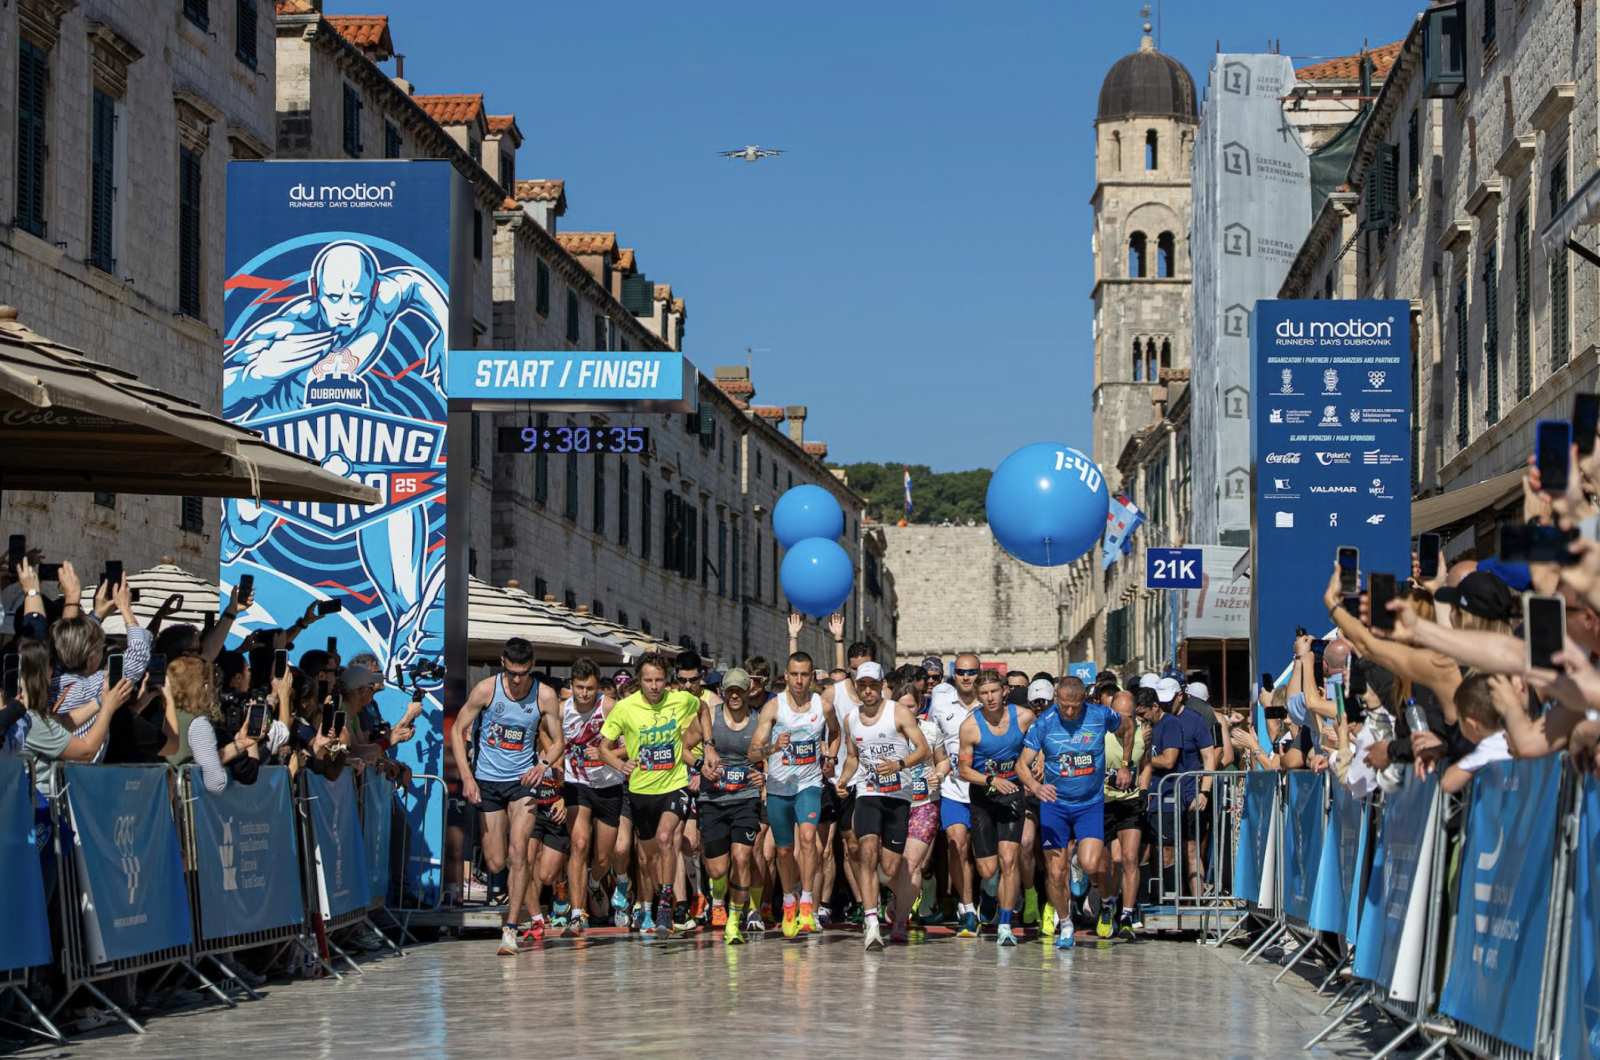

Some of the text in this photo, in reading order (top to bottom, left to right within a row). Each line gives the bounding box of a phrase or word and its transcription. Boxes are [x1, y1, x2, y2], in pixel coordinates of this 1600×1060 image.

[1256, 157, 1292, 168] LIBERTAS
[1257, 164, 1304, 178] INŽENJERING
[289, 182, 394, 200] du motion
[1258, 238, 1294, 250] LIBERTAS
[1276, 318, 1391, 338] du motion
[475, 359, 660, 388] START / FINISH
[310, 388, 362, 400] DUBROVNIK
[521, 427, 644, 452] 9:30:35
[1055, 451, 1102, 493] 1:40
[395, 478, 417, 493] 25
[1154, 559, 1196, 579] 21K
[1076, 668, 1091, 679] 5K
[504, 729, 523, 740] 1689
[653, 749, 672, 760] 2135
[796, 744, 813, 754] 1624
[1000, 760, 1014, 770] 1717
[1074, 754, 1092, 766] 1029
[727, 771, 744, 780] 1564
